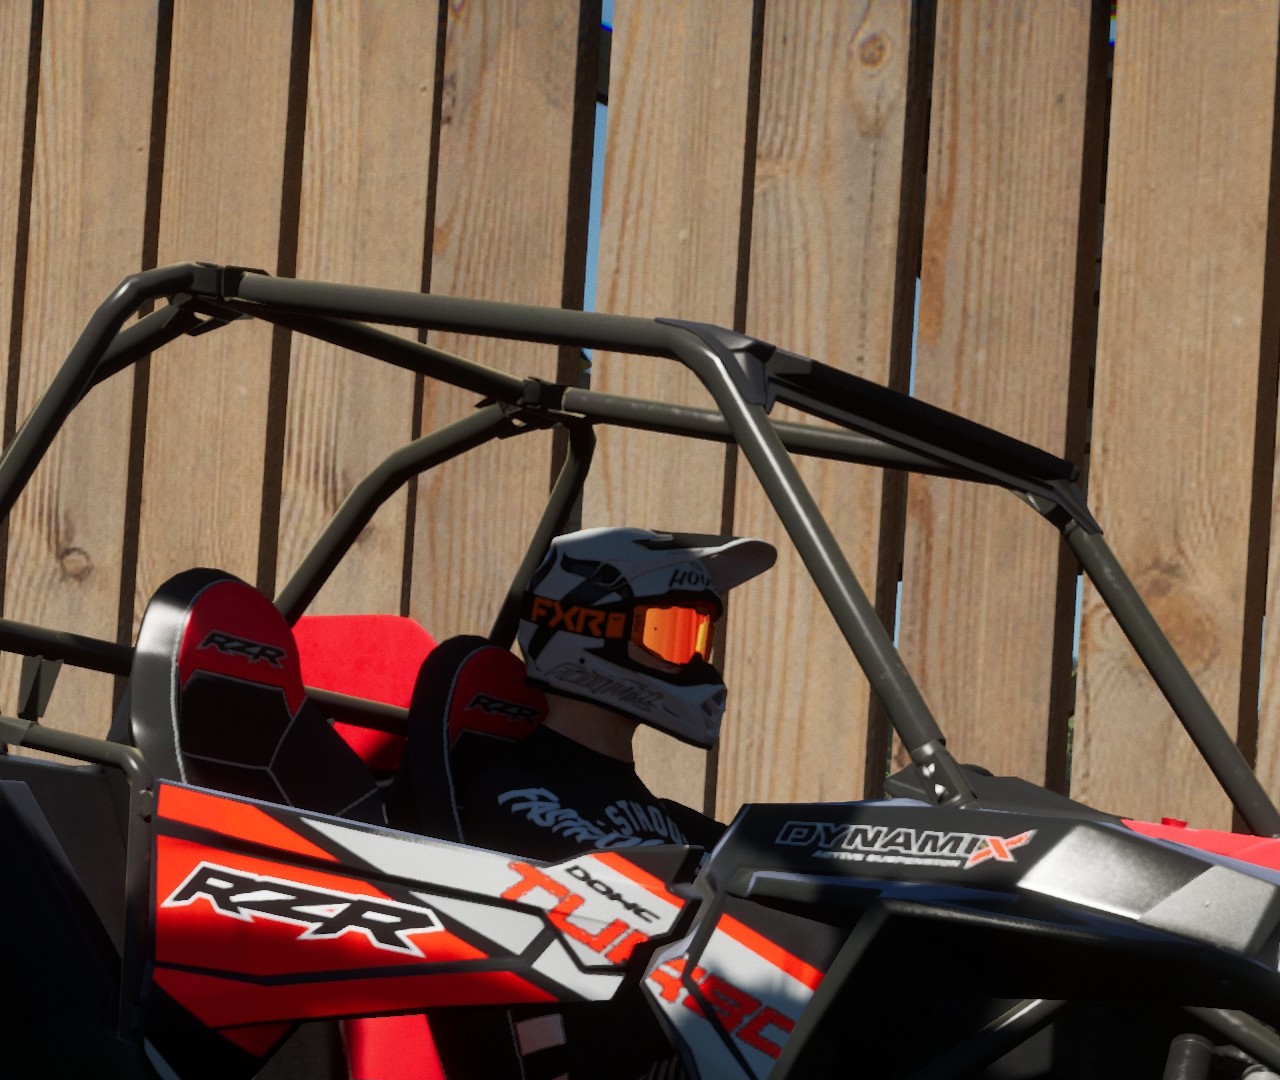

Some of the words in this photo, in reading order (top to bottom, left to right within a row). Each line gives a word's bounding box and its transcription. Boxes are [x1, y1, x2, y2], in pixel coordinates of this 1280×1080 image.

[531, 597, 607, 638] FXR
[196, 629, 289, 670] RZR
[464, 692, 540, 730] RZR
[774, 820, 1038, 871] DYNAMIX
[161, 860, 445, 957] RZR
[565, 865, 662, 924] DOHC
